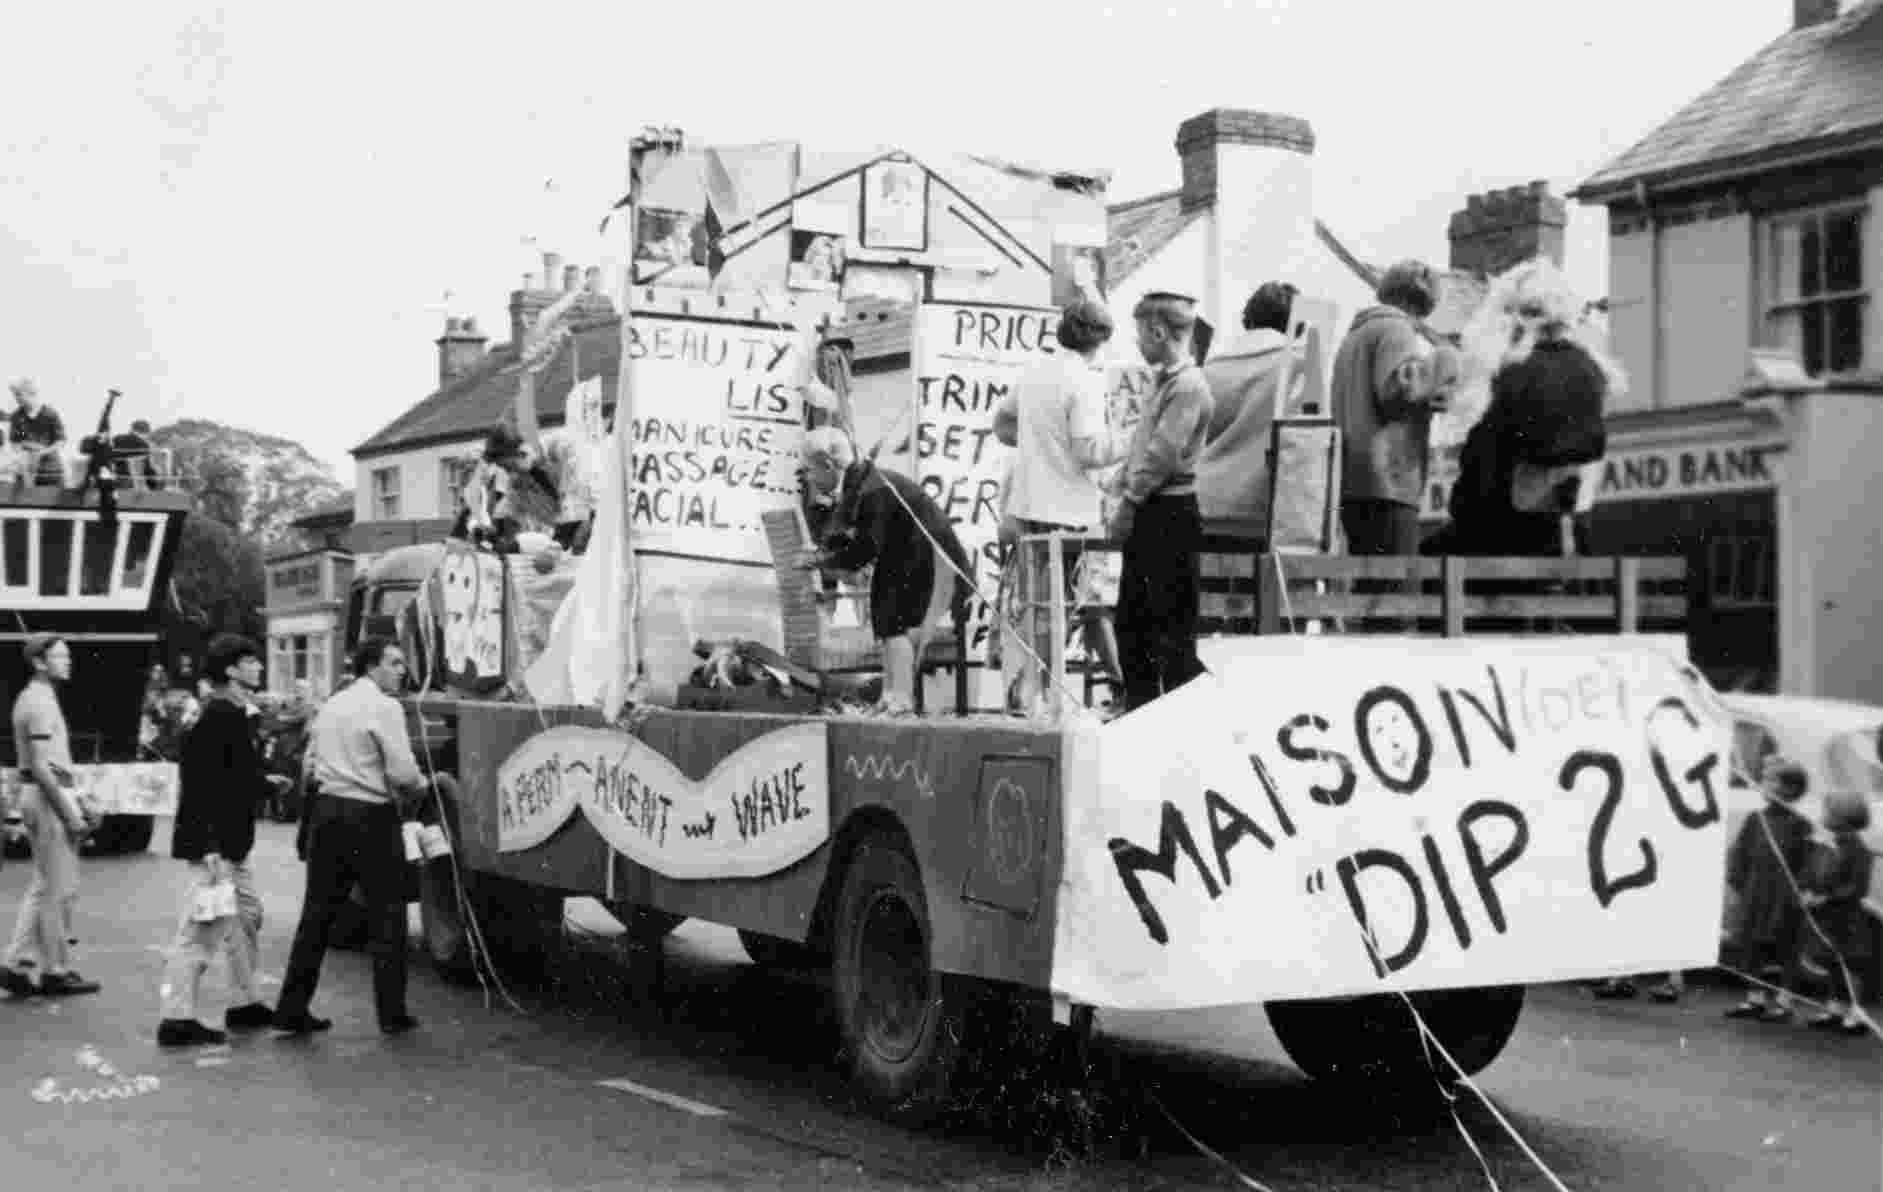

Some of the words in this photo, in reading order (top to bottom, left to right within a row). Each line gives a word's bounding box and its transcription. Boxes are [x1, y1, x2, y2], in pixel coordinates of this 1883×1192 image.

[628, 326, 792, 372] BEAUTY
[954, 309, 1057, 355] PRICE
[917, 422, 992, 466] SET
[1680, 450, 1770, 486] BANK
[731, 762, 810, 843] WAVE
[1107, 664, 1515, 945] MAISON
